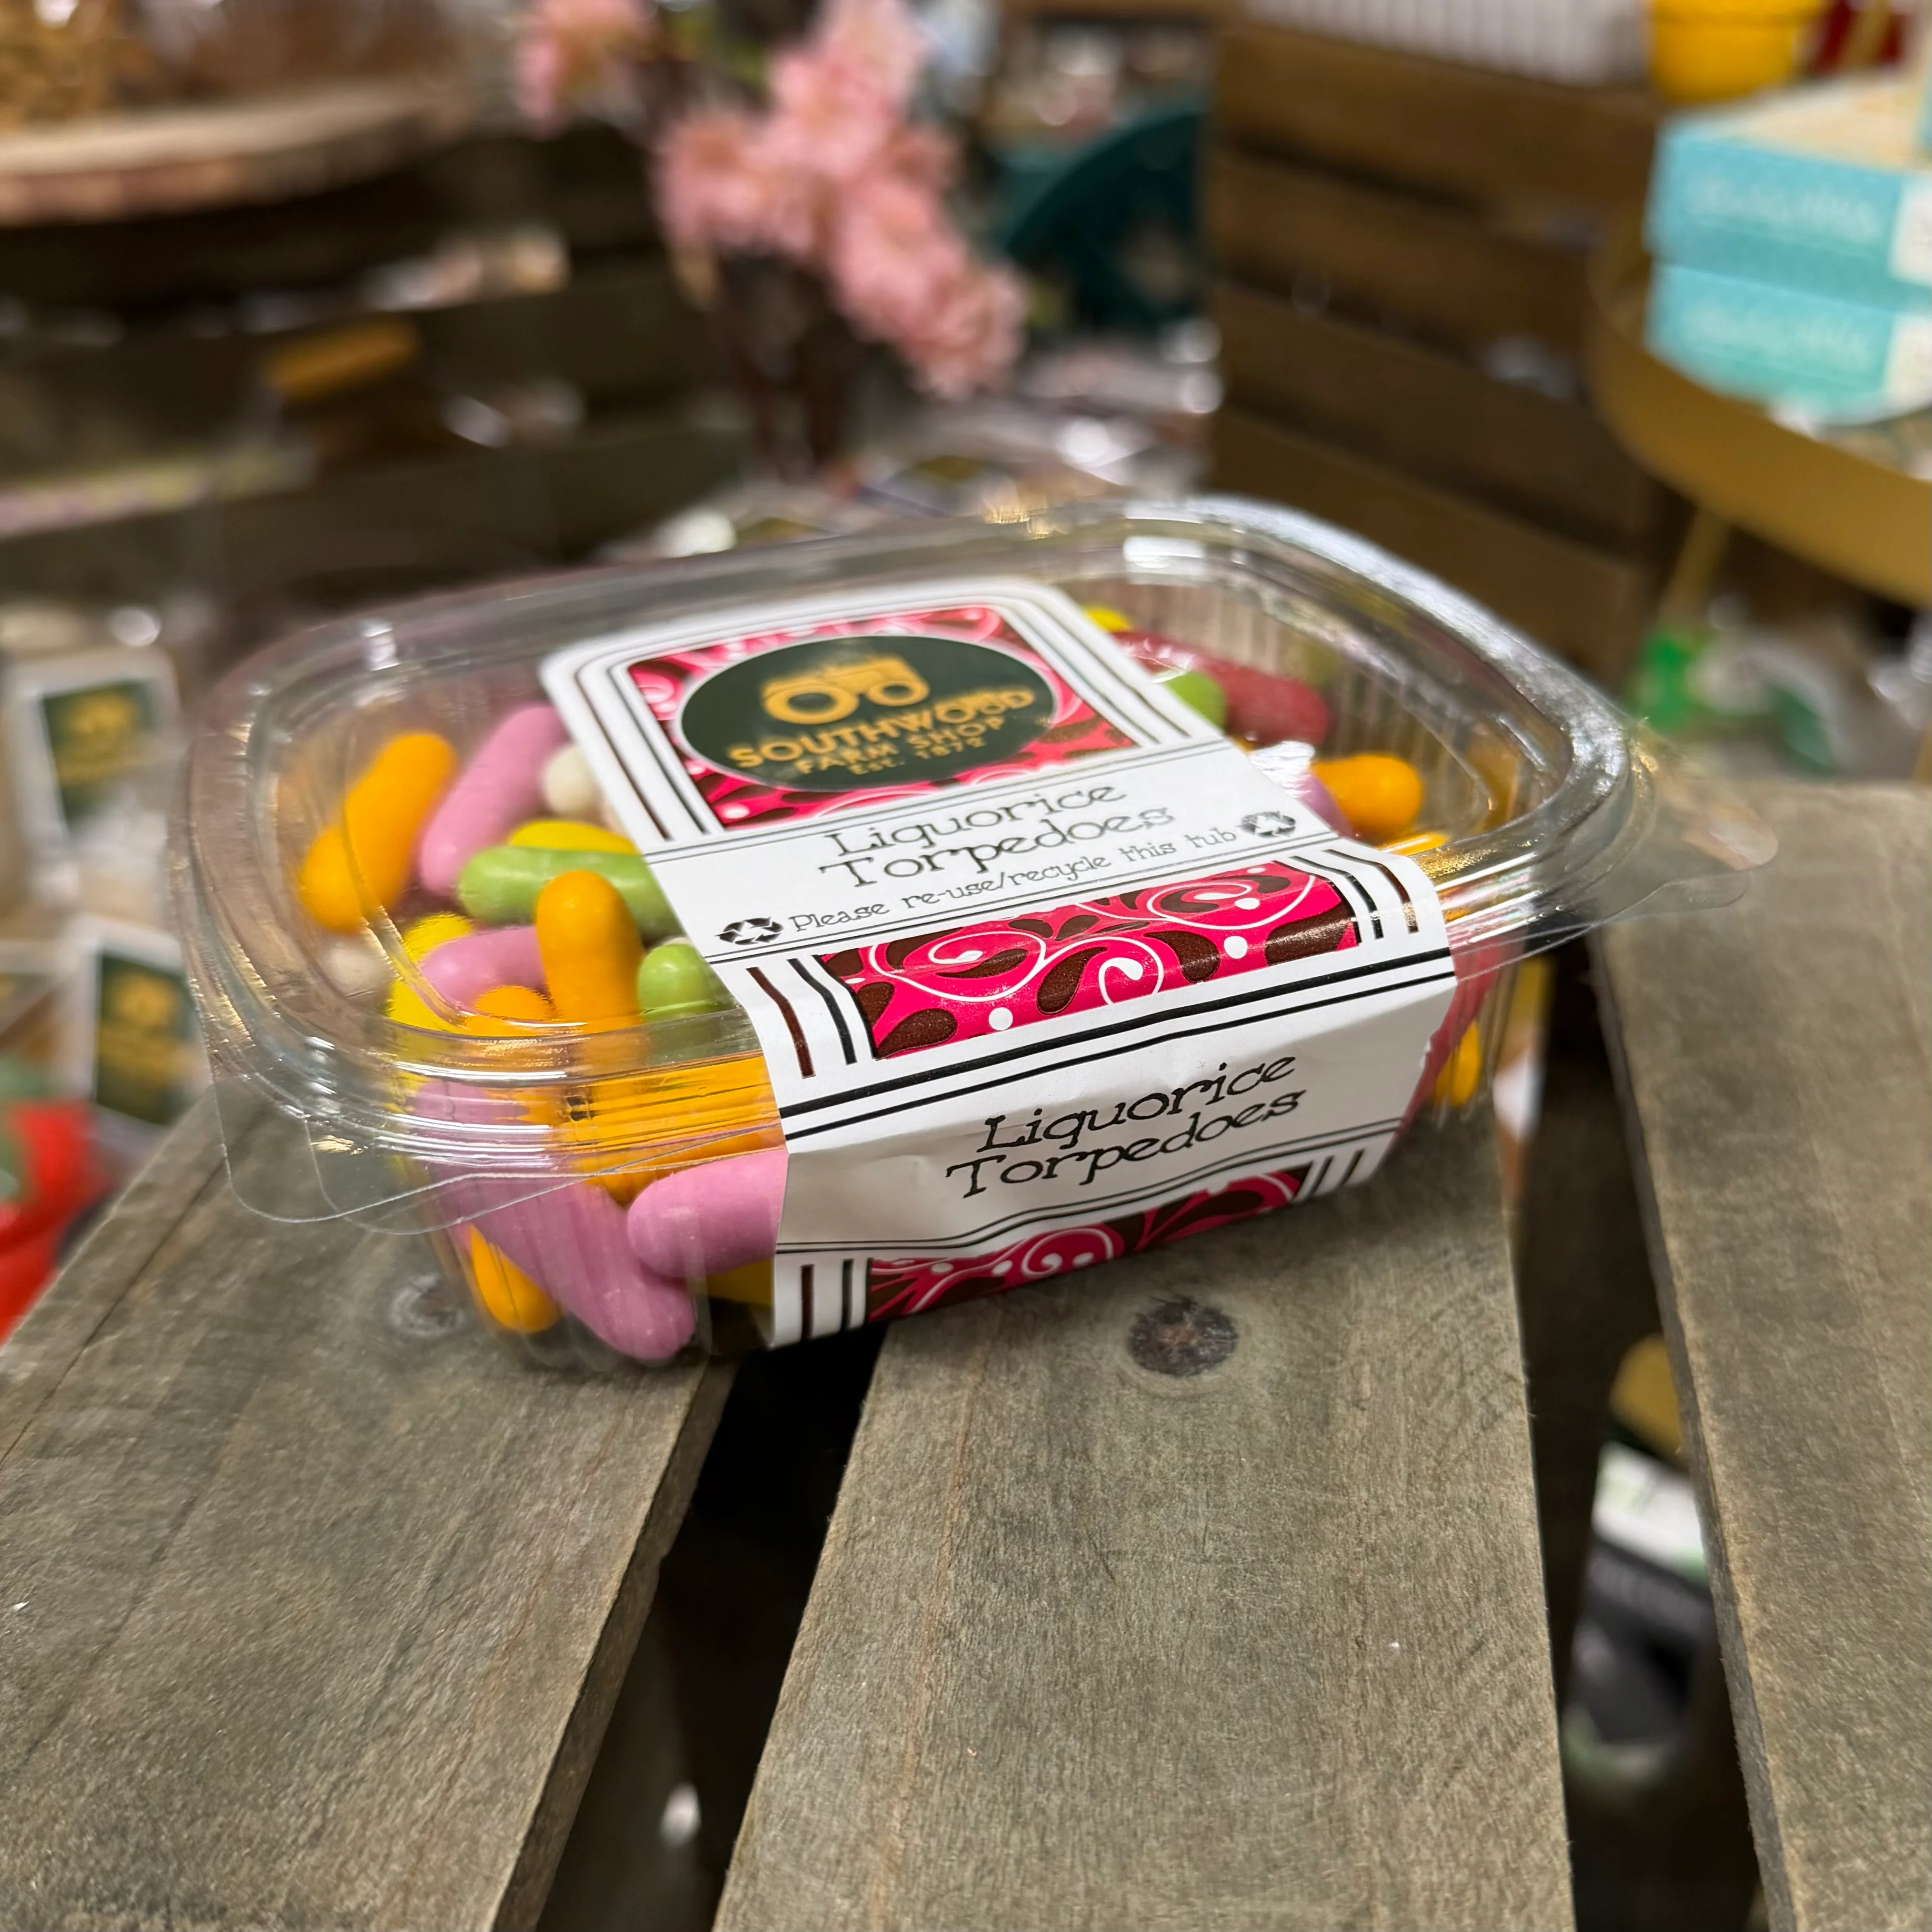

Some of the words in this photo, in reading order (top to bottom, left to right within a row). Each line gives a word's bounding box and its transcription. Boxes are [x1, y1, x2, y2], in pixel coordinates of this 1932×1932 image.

[729, 689, 1035, 768] SOUTHWOOD
[795, 741, 898, 774] FARM
[907, 716, 1004, 748] SHOP
[818, 807, 1176, 888] Torpedoes
[824, 786, 1127, 856] Liquorice
[789, 903, 890, 932] Please
[901, 856, 1112, 909] re-use/recycle
[1119, 842, 1177, 862] this
[1184, 828, 1236, 848] tub
[946, 1090, 1306, 1198] Torpedoes
[976, 1057, 1296, 1151] Liquorice
